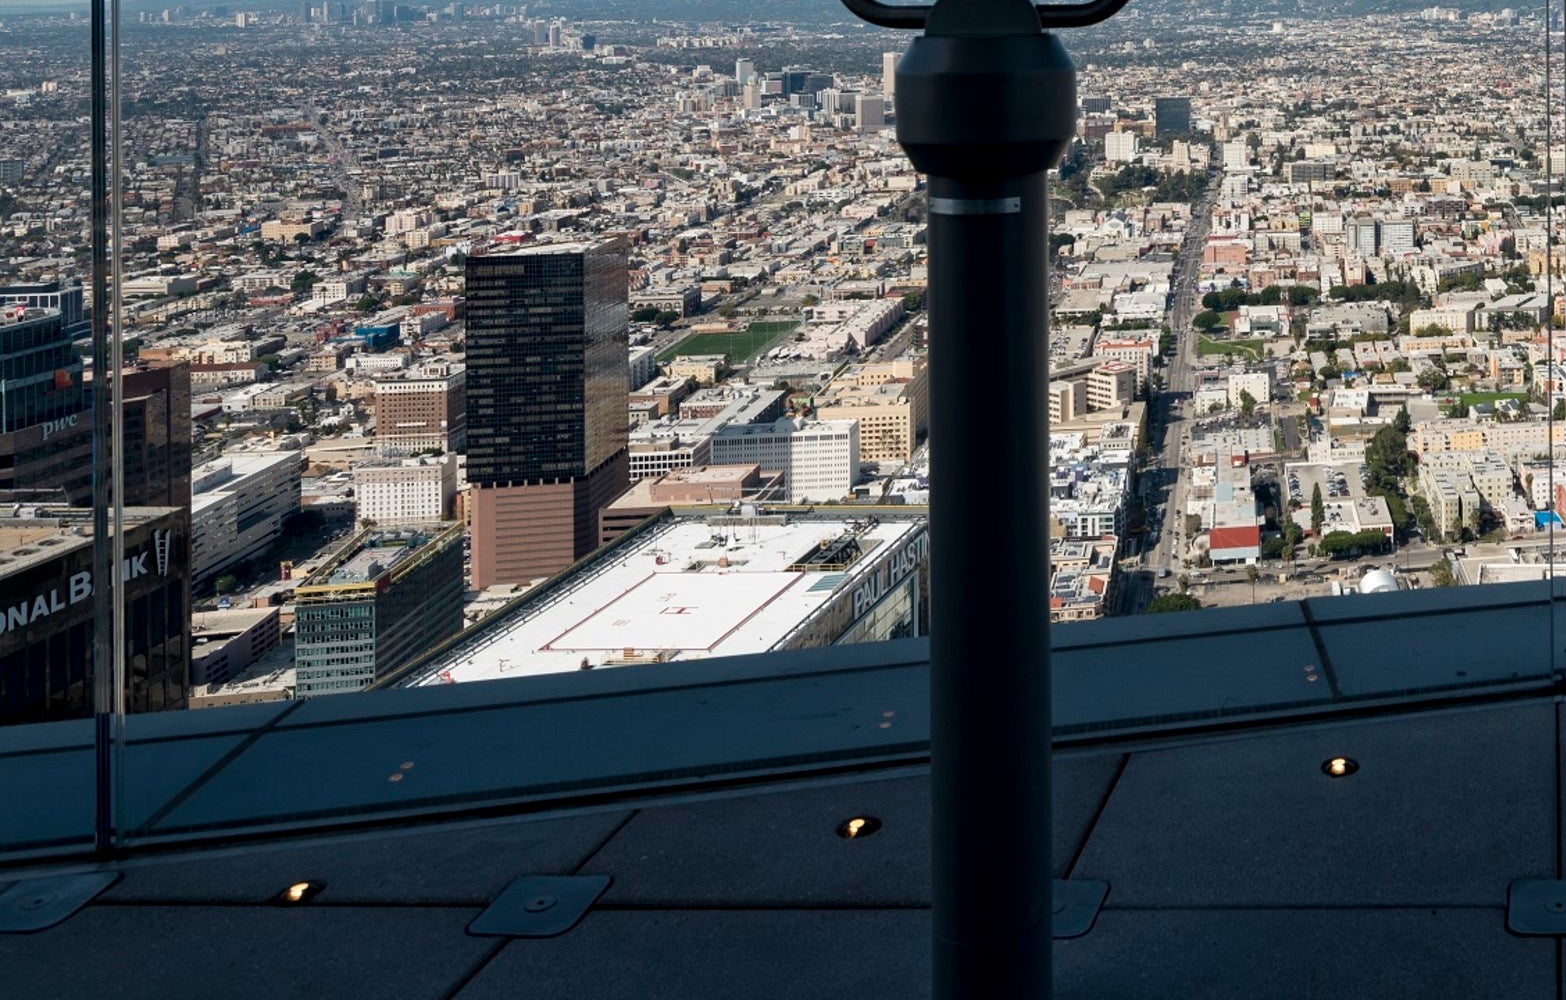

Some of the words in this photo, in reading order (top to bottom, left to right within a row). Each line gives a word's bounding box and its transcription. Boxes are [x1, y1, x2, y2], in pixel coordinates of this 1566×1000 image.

[42, 413, 78, 441] pwc
[70, 551, 149, 605] BNK
[853, 571, 889, 620] PAUL
